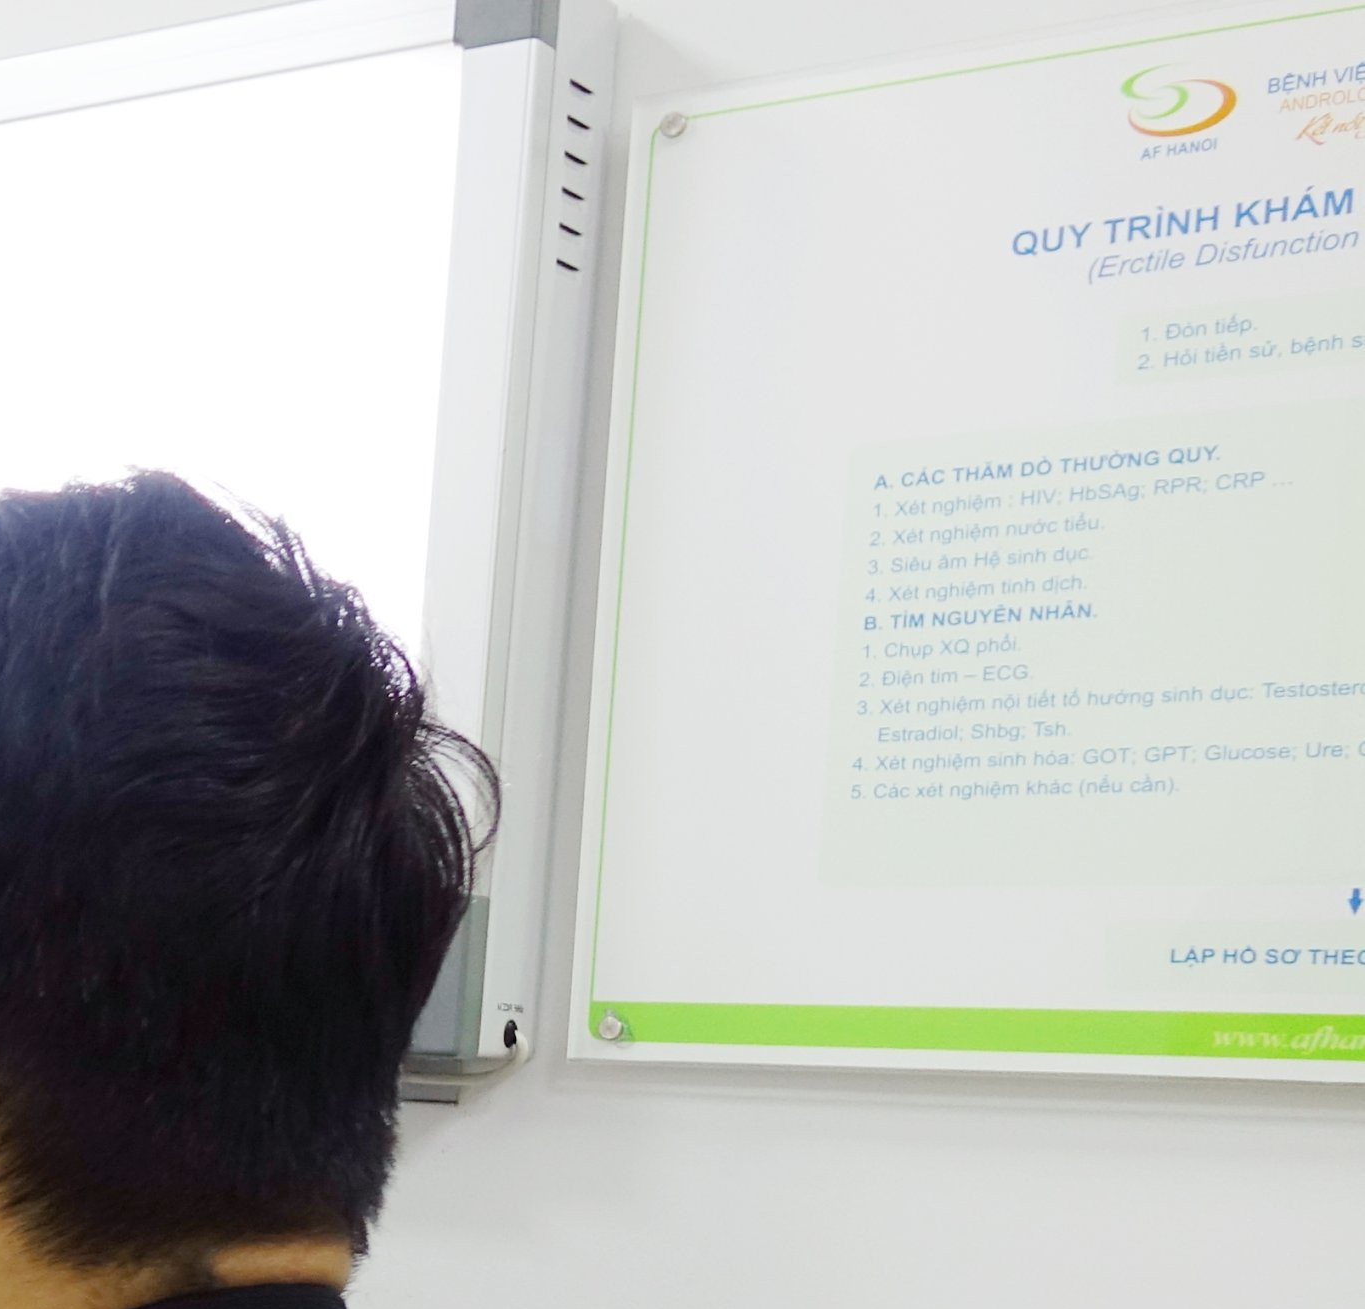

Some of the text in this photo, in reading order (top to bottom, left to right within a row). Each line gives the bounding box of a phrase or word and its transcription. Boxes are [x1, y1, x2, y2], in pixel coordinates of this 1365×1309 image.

[1268, 71, 1326, 95] BỆNH
[1140, 138, 1219, 161] AF HANOI
[1012, 186, 1355, 256] QUY TRÌNH KHÁM
[1087, 229, 1359, 285] (Erctile Disfunction
[1290, 334, 1343, 356] bệnh
[874, 474, 893, 490] A.
[900, 466, 945, 488] CÁC
[1020, 456, 1052, 477] DÒ
[1060, 450, 1160, 473] THƯỜNG
[1167, 444, 1221, 464] QUY.
[932, 494, 1002, 517] nghiệm
[1153, 475, 1208, 496] RPR;
[1215, 471, 1266, 491] CRP
[930, 523, 998, 546] nghiệm
[1006, 548, 1047, 566] sinh
[925, 581, 995, 602] nghiệm
[864, 600, 1098, 630] B. TÌM NGUYÊN NHÂN.
[940, 638, 970, 656] XQ
[916, 696, 985, 717] nghiệm
[1161, 685, 1204, 704] sinh
[912, 752, 981, 773] nghiệm
[987, 751, 1026, 768] sinh
[1205, 744, 1298, 763] Glucose;
[950, 779, 1019, 800] nghiệm
[1265, 948, 1301, 965] SƠ
